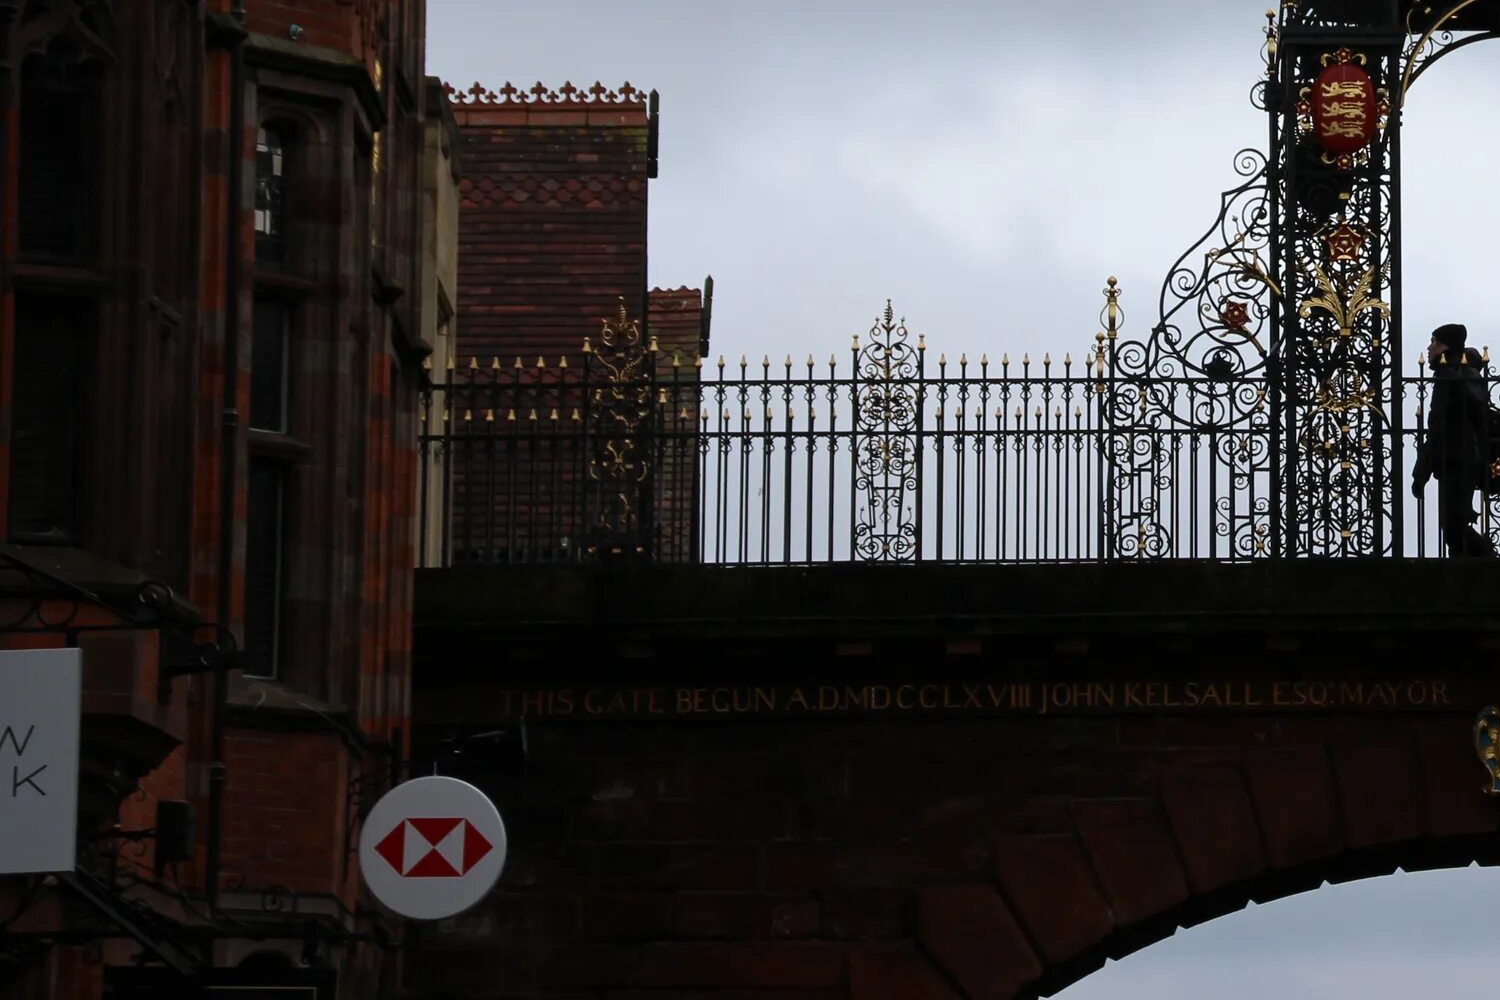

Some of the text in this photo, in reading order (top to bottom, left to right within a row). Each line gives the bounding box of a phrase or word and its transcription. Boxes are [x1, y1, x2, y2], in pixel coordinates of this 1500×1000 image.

[497, 687, 577, 715] THIS
[583, 687, 665, 714] GATE
[675, 685, 775, 713] BEGUN
[1039, 682, 1115, 713] JOHN
[1124, 681, 1264, 707] KELSALL
[1342, 680, 1452, 706] MAYOR
